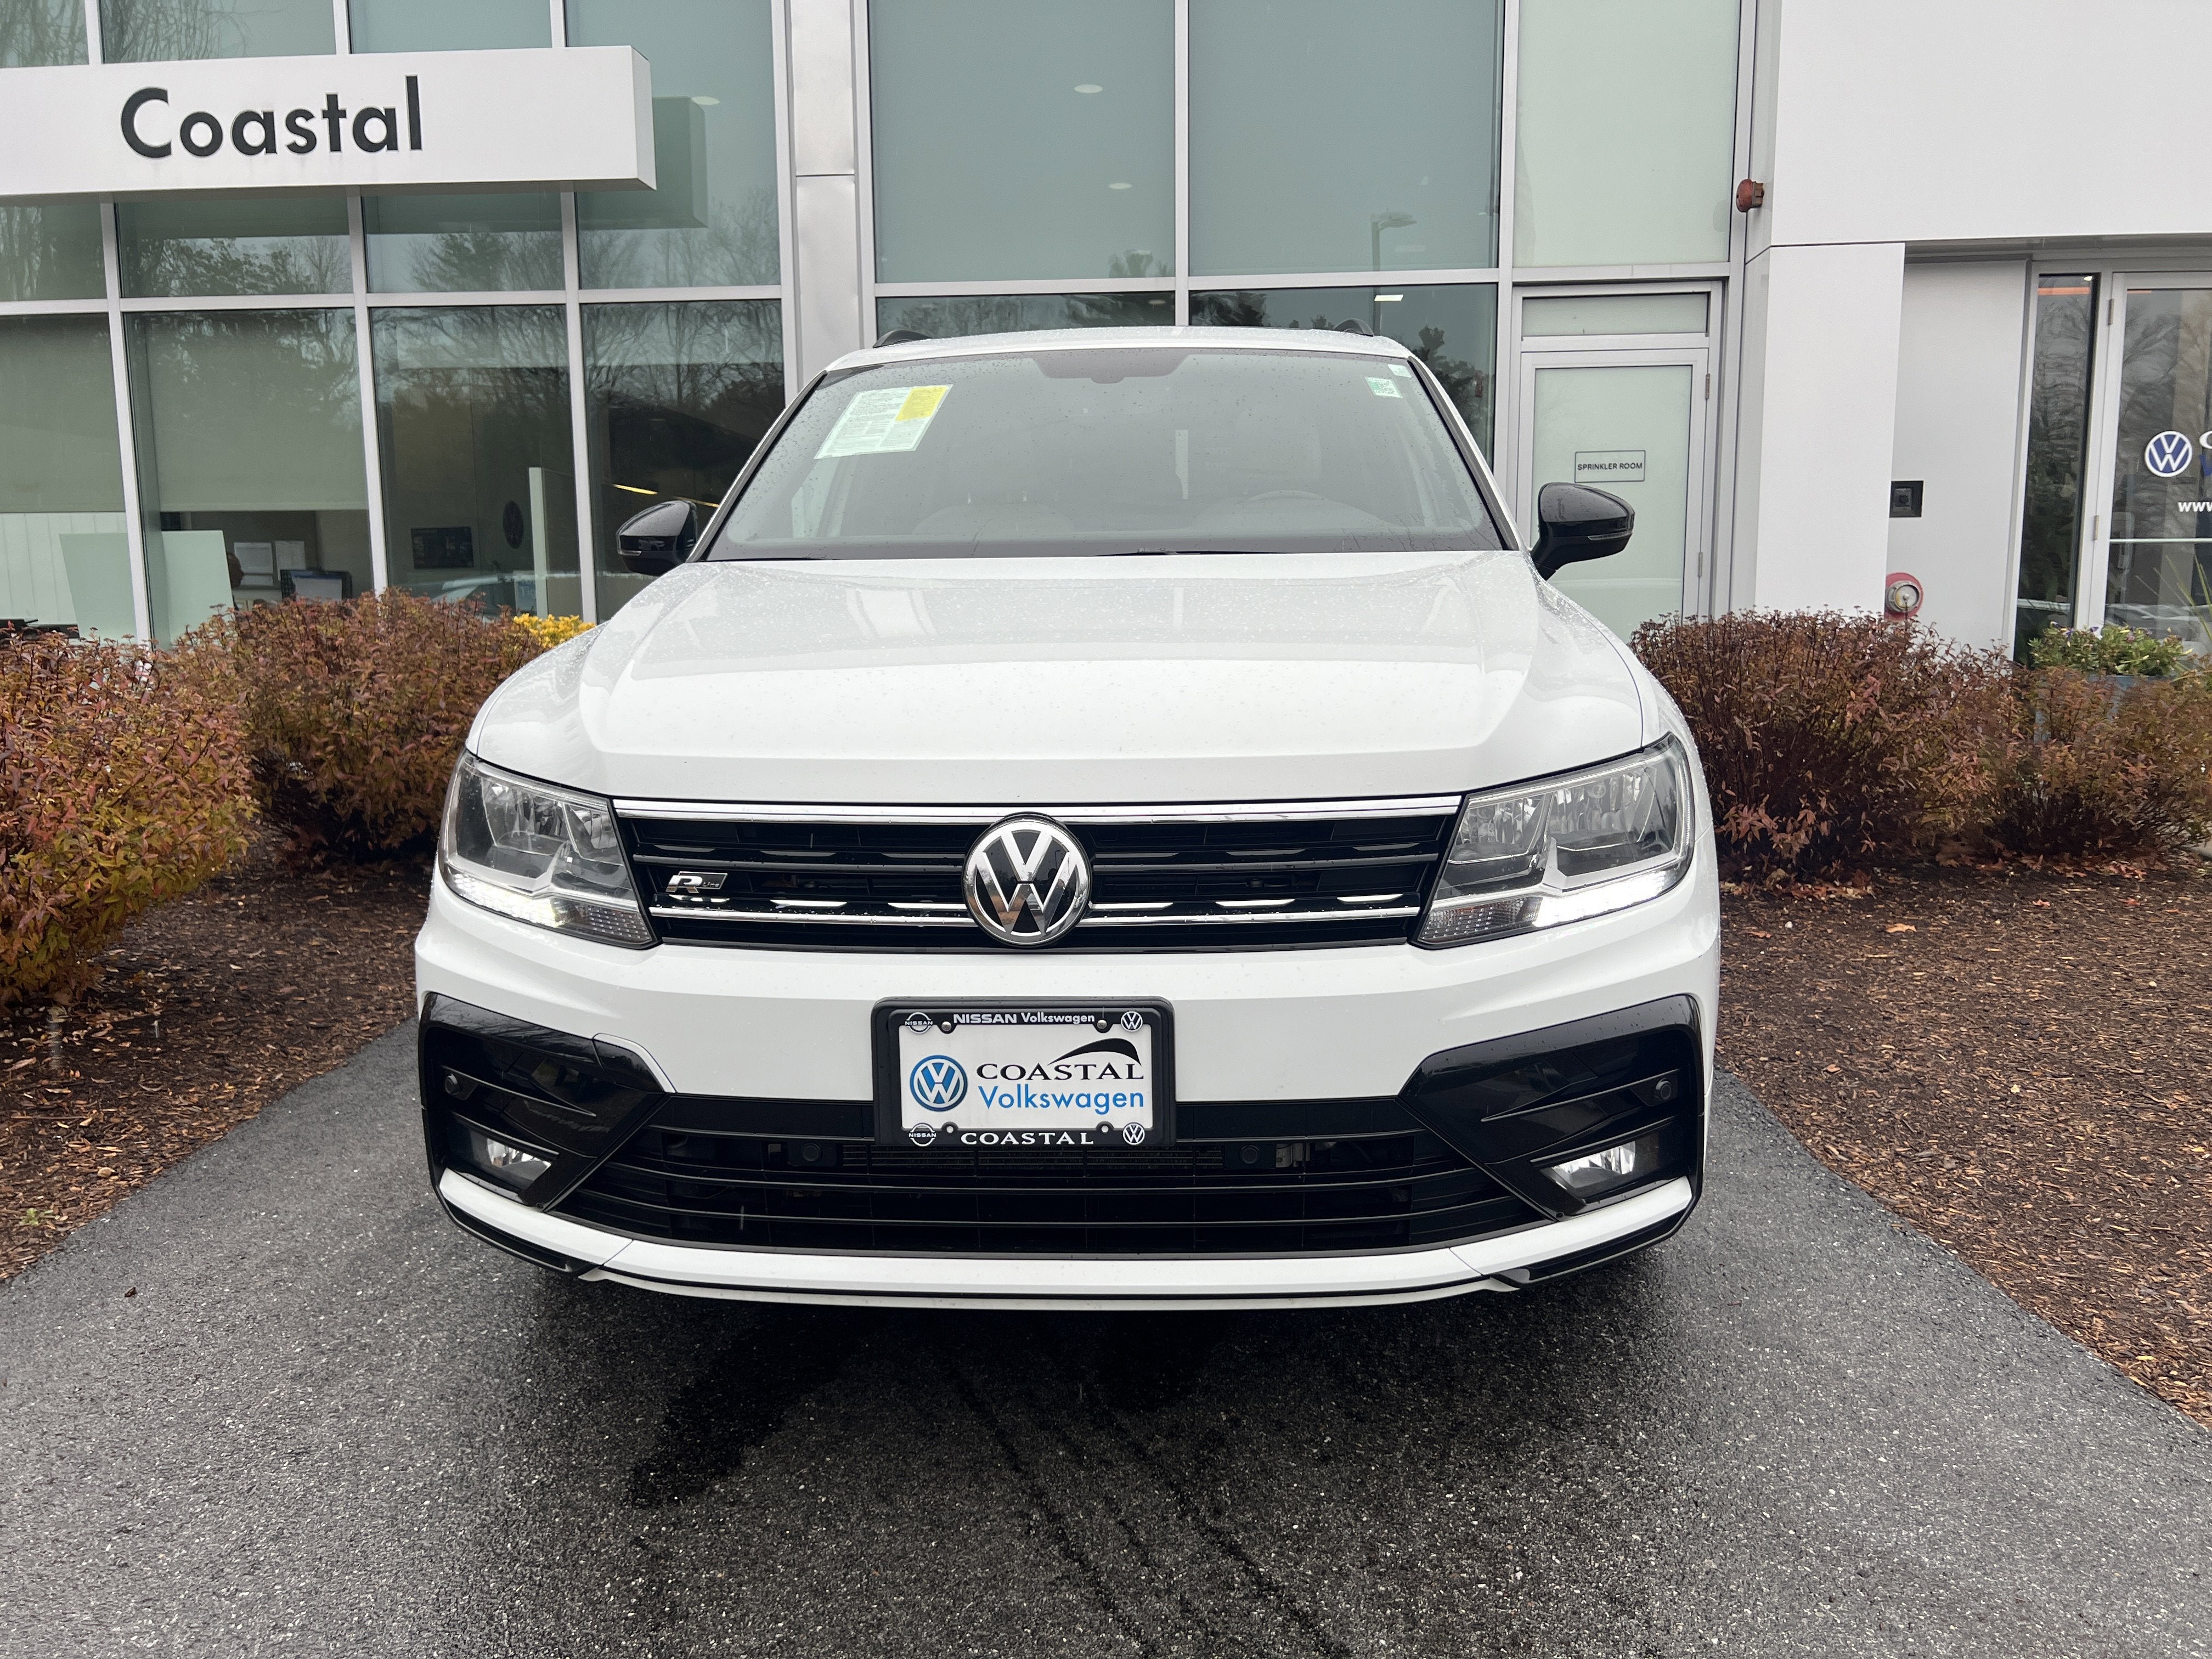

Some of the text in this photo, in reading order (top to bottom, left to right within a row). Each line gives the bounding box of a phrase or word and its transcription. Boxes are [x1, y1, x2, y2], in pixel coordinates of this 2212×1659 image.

[120, 75, 423, 158] Coastal
[953, 1012, 1094, 1024] NISSAN Volkswagen
[977, 1062, 1144, 1081] COASTAL
[978, 1084, 1144, 1115] Volkswagen
[961, 1132, 1094, 1145] COASTAL
